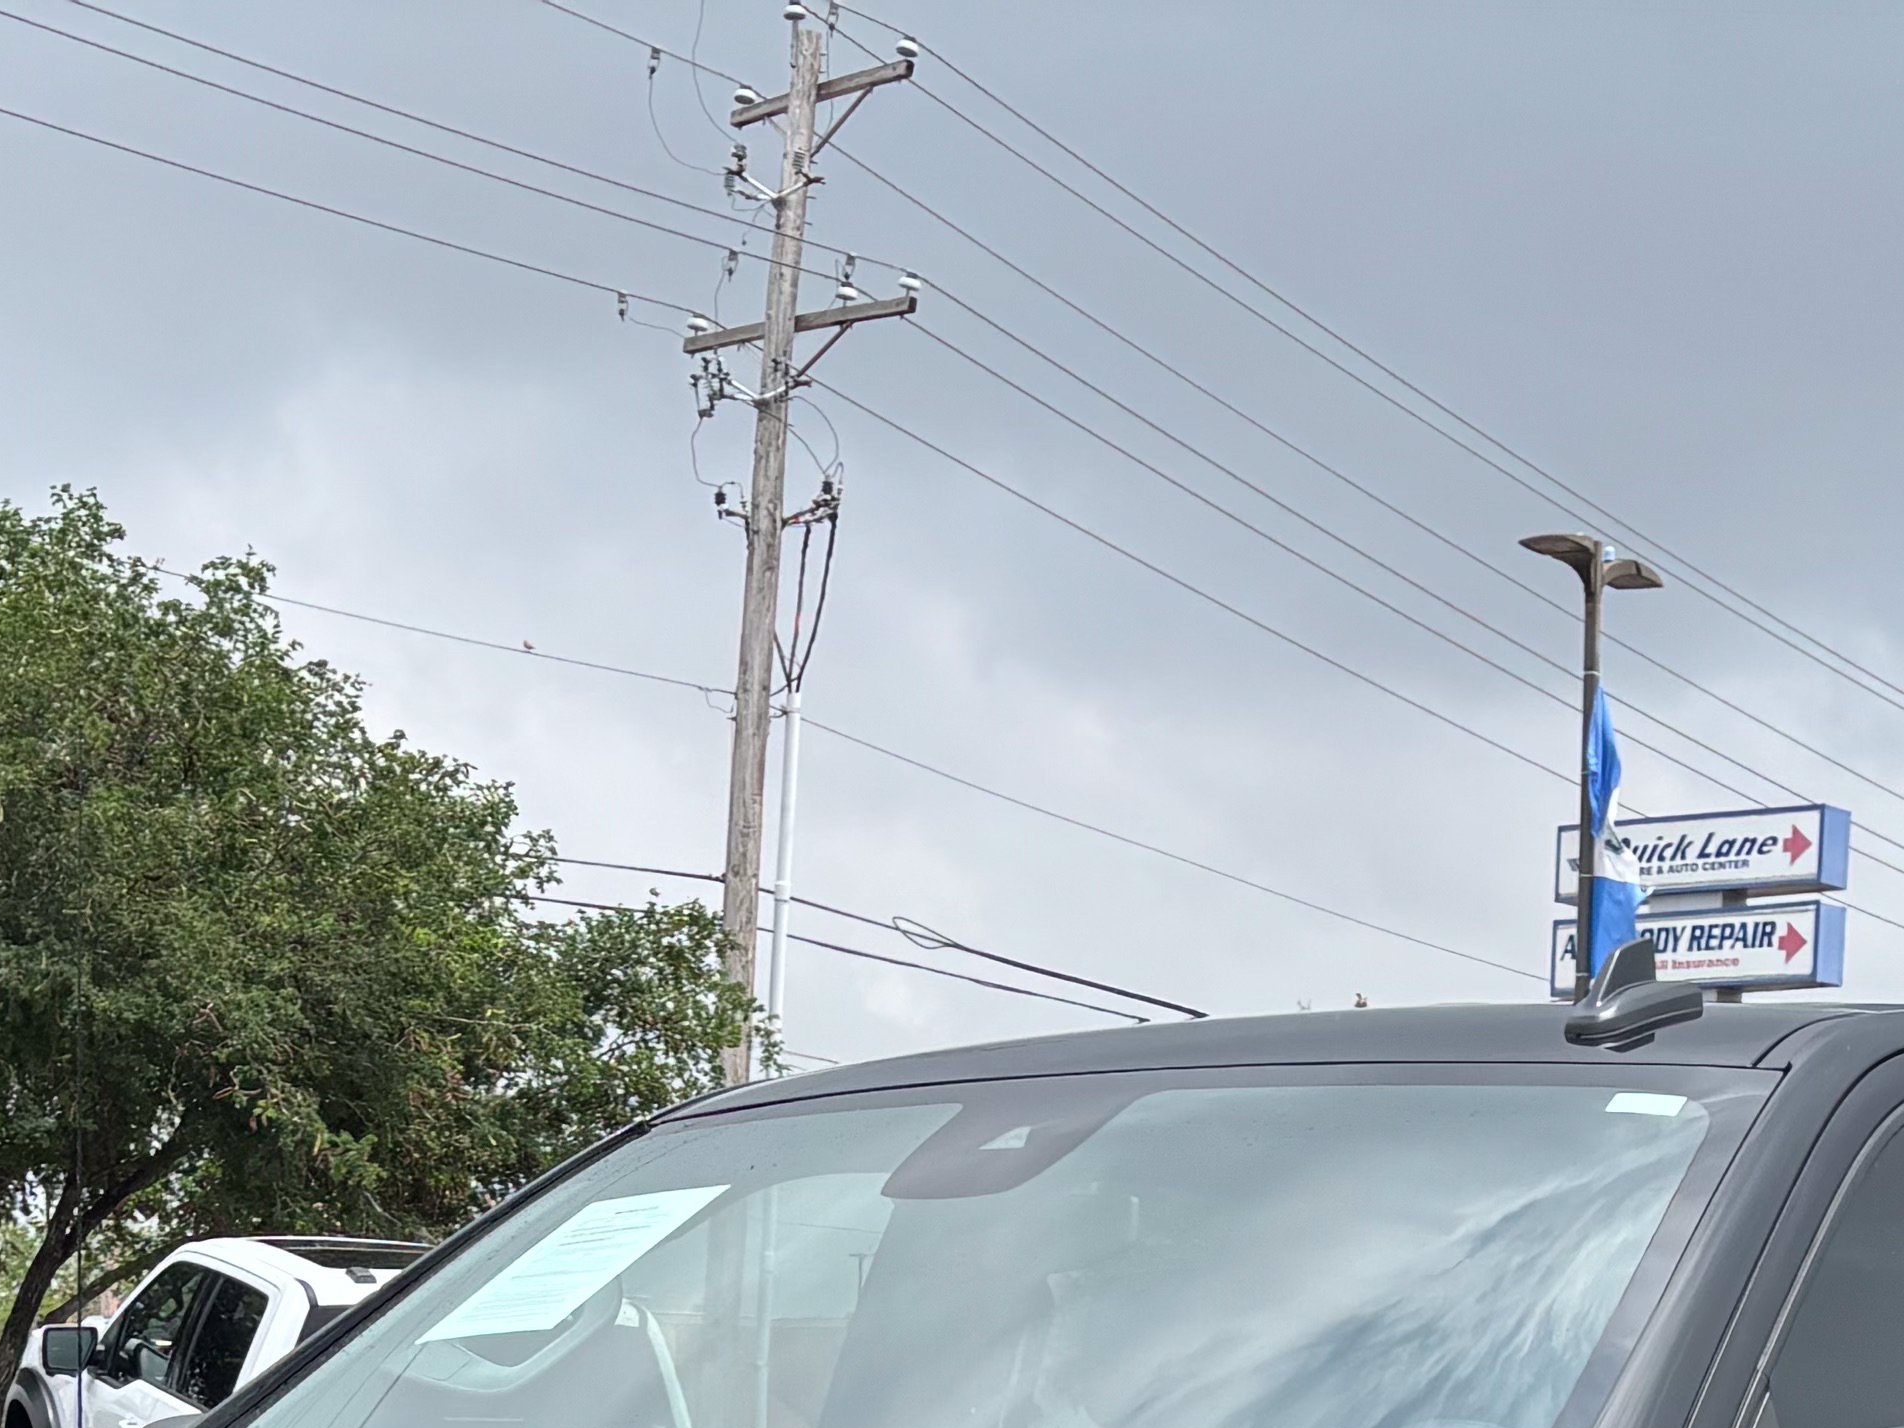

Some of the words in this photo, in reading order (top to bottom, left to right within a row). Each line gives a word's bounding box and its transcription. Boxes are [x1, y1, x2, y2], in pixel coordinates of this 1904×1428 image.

[1696, 832, 1778, 859] Lane
[1667, 862, 1699, 874] AUTO
[1701, 859, 1750, 871] CENTER
[1687, 921, 1777, 952] REPAIR
[1671, 958, 1740, 969] Insurance
